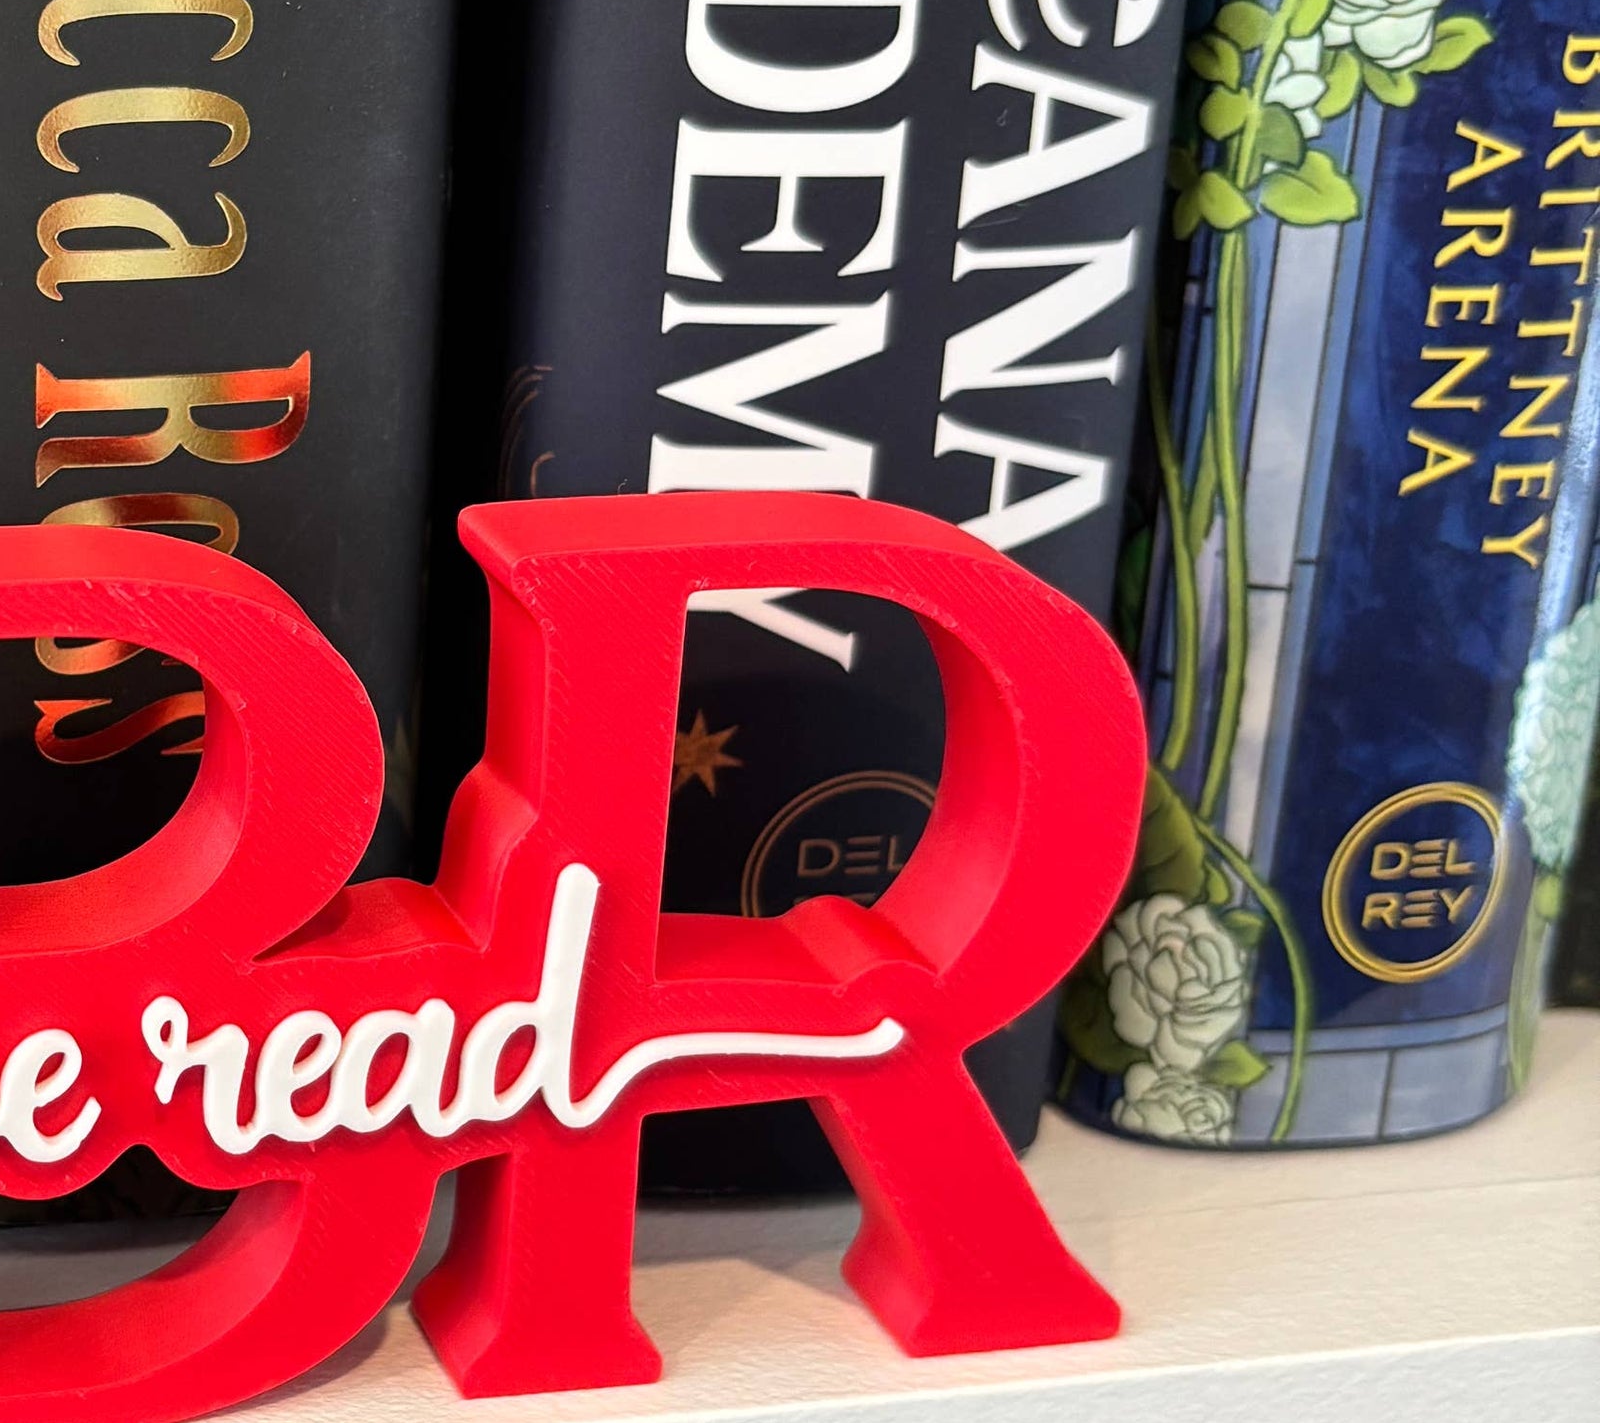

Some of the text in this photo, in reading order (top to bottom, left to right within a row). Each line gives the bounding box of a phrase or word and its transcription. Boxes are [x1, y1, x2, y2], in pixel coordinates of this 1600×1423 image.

[1398, 119, 1525, 498] ARENA
[1480, 32, 1600, 571] BRITTNEY
[33, 349, 312, 765] Ros
[796, 834, 905, 878] DEL
[1360, 884, 1477, 930] REY
[1369, 837, 1477, 880] DEL
[140, 862, 904, 1155] read
